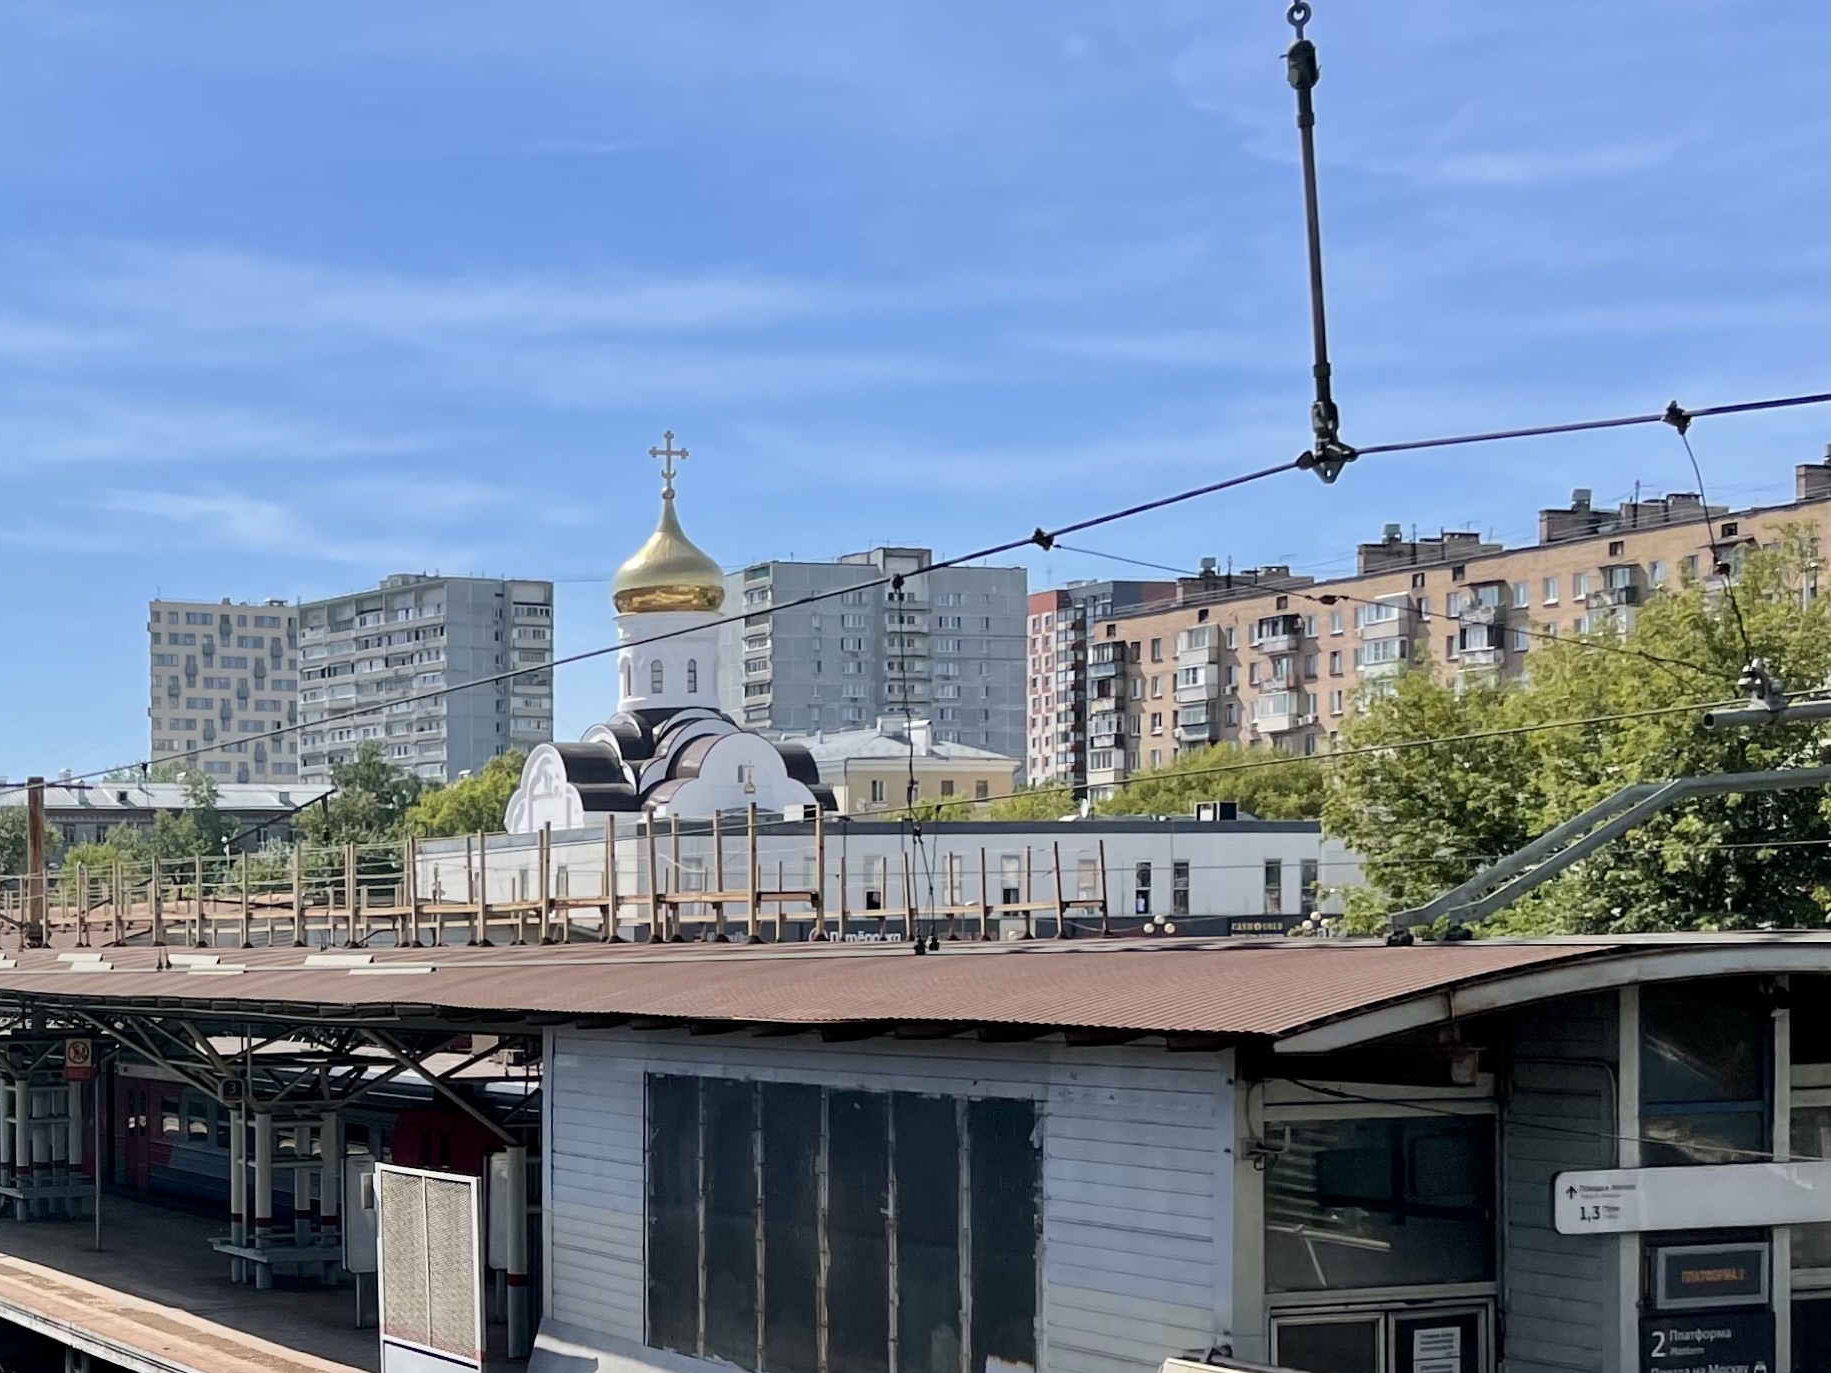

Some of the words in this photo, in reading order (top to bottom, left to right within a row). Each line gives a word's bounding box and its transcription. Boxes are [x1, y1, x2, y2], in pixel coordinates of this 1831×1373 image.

[1579, 1205, 1601, 1222] 1,3
[1670, 1328, 1732, 1343] Платформа
[1651, 1331, 1667, 1358] 2
